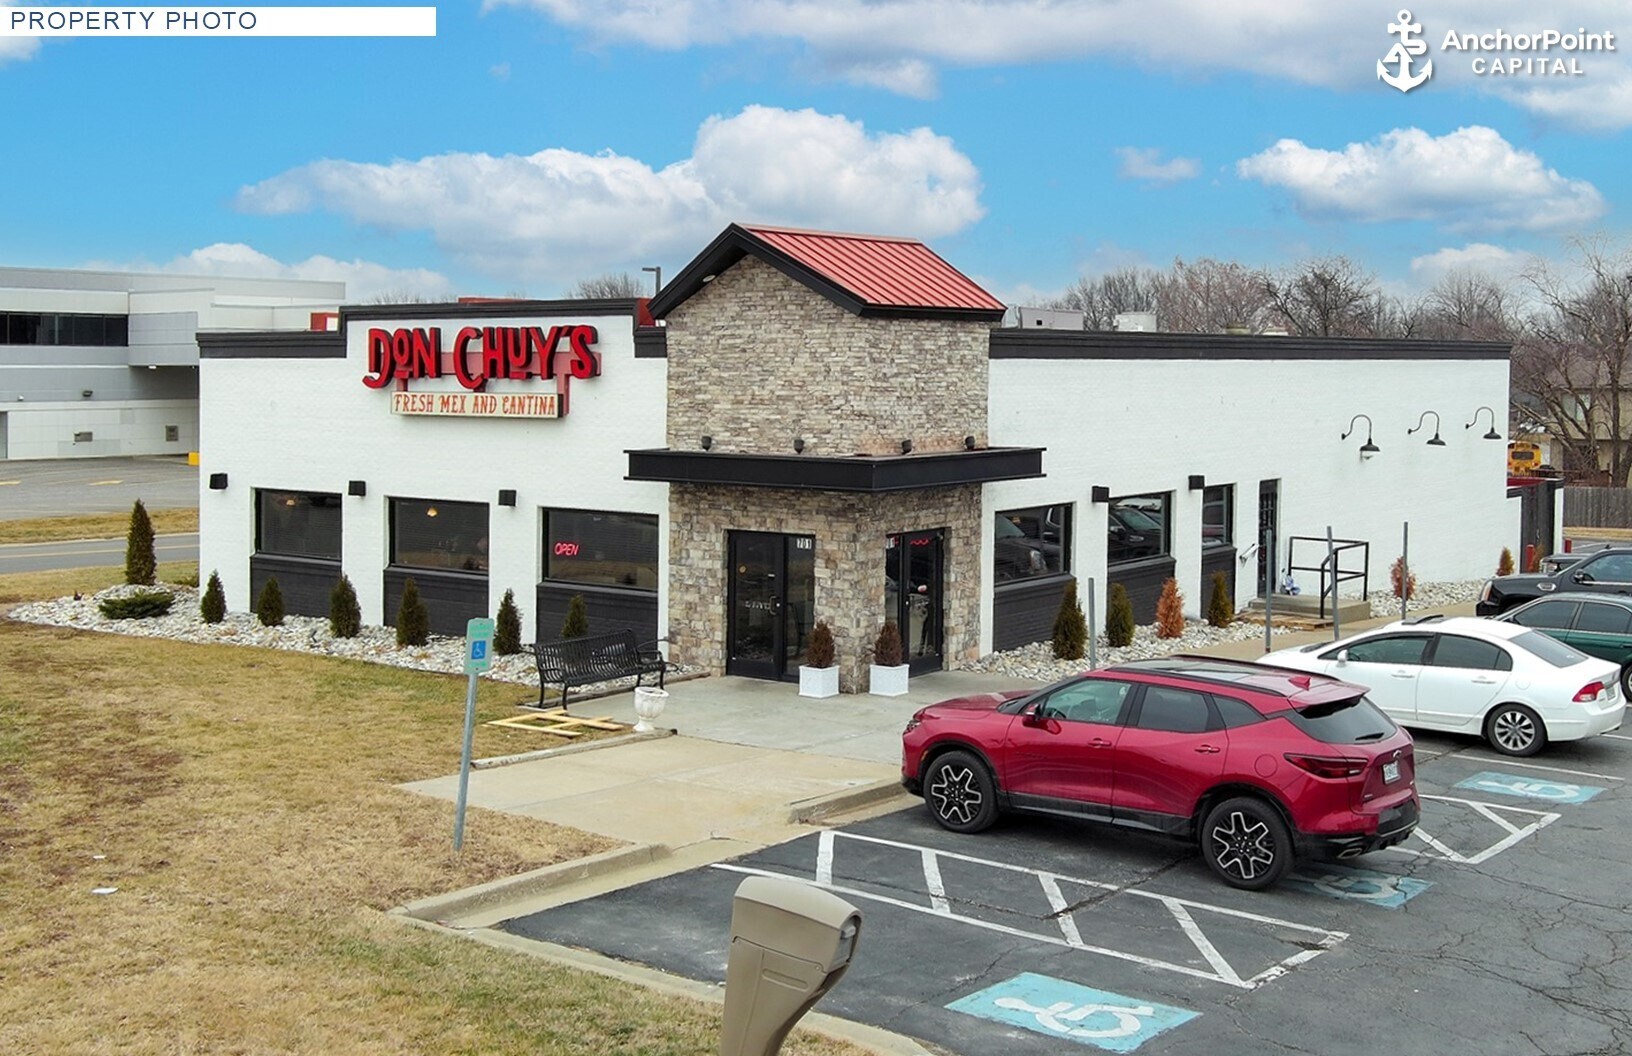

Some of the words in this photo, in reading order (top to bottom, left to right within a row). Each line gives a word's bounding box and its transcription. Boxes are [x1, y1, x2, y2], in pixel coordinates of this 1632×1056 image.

[362, 327, 442, 389] DON
[453, 324, 598, 390] CHUY'S
[394, 393, 434, 414] FRESH
[439, 393, 467, 414] MEX
[472, 394, 497, 415] AND
[502, 394, 556, 416] CANTINA
[554, 542, 579, 556] OPEN
